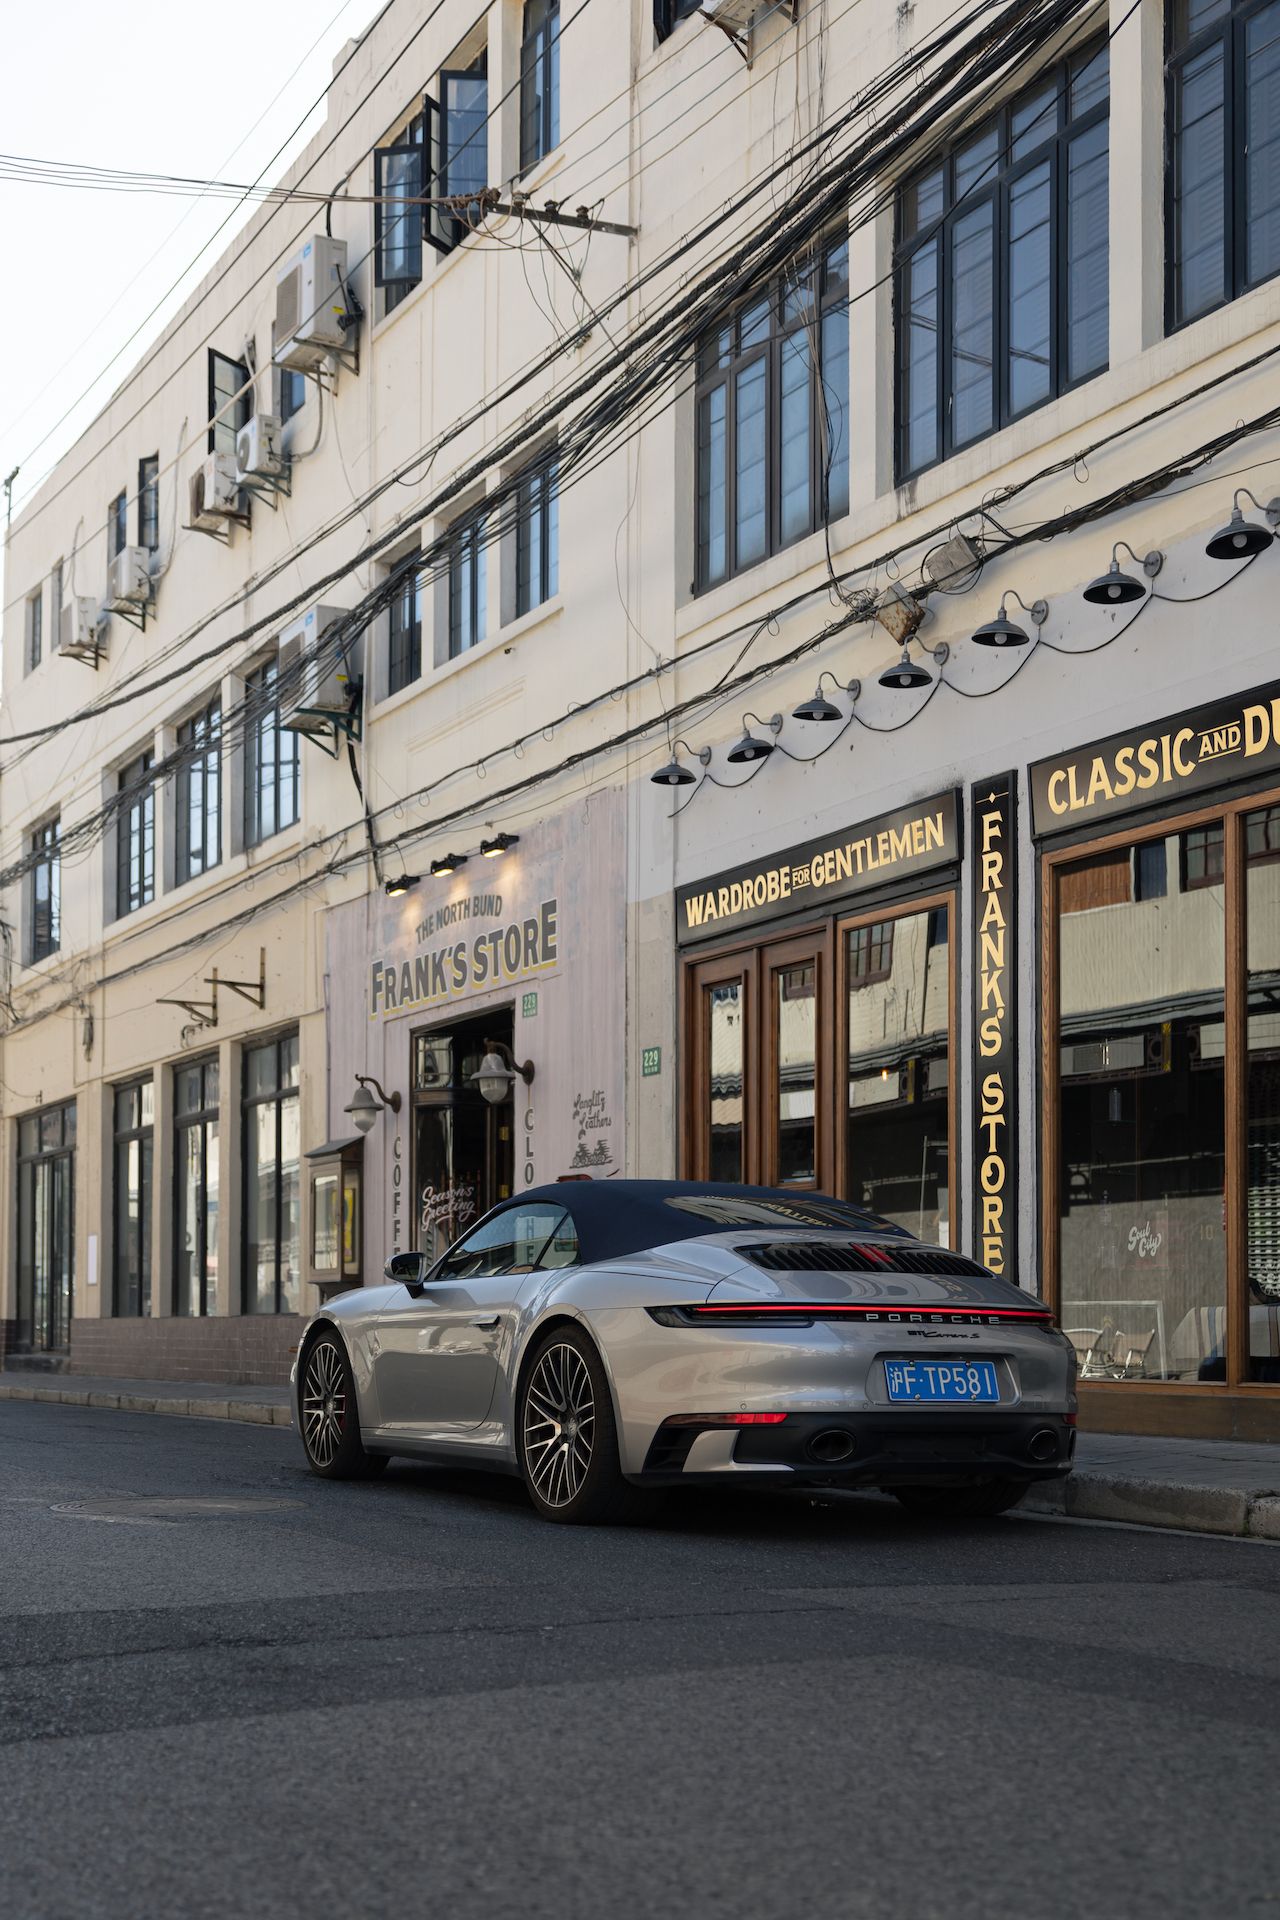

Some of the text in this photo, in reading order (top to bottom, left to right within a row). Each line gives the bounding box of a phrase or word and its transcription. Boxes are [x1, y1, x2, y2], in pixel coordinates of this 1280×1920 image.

[1048, 727, 1197, 815] CLASSIC
[1199, 725, 1241, 757] AND
[685, 812, 944, 928] WARDROBE FOR GENTLEMEN
[416, 894, 503, 944] THE NORTH BUND
[371, 898, 557, 1016] FRANK'S STORE
[643, 1050, 659, 1067] 229
[978, 811, 1006, 1275] FRANK'S STORE
[1128, 1221, 1151, 1251] Soul
[1139, 1233, 1162, 1257] City
[866, 1313, 1000, 1324] PORSCHE
